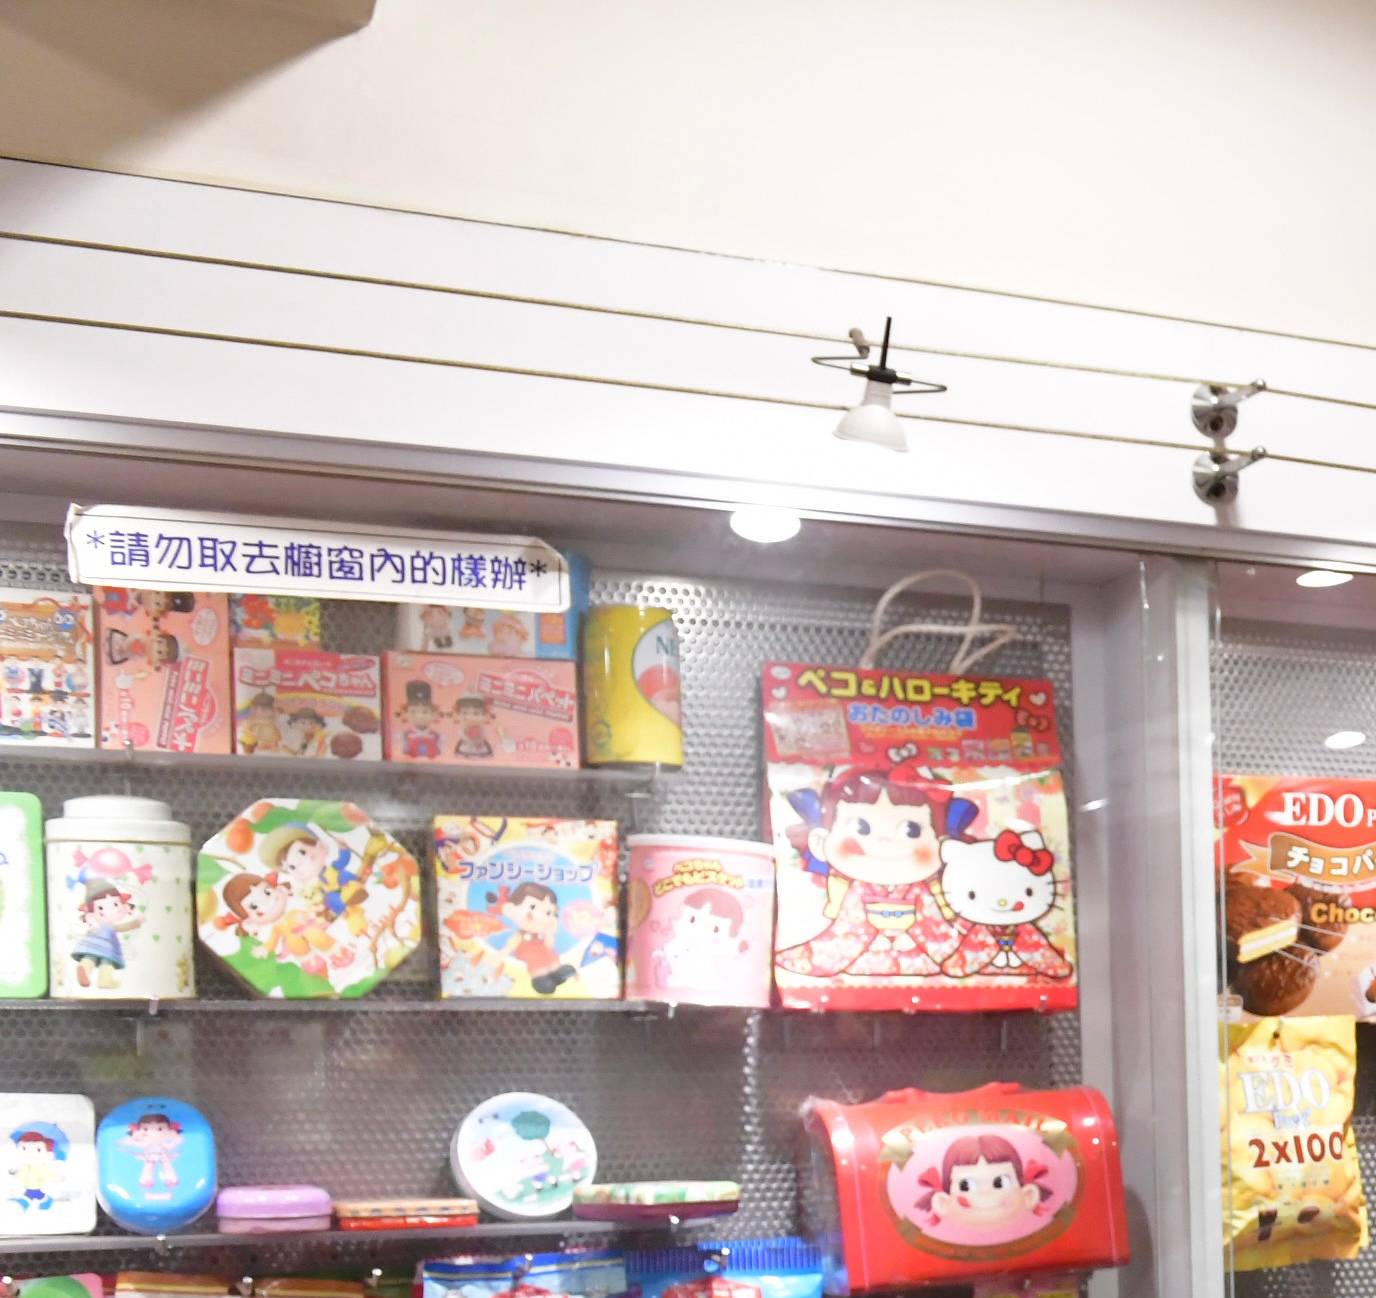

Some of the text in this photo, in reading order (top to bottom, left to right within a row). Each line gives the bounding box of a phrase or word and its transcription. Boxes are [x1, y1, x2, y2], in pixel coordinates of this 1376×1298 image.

[1280, 791, 1364, 828] EDO
[458, 859, 596, 884] ファンシーショップ
[1236, 1069, 1330, 1114] EDO
